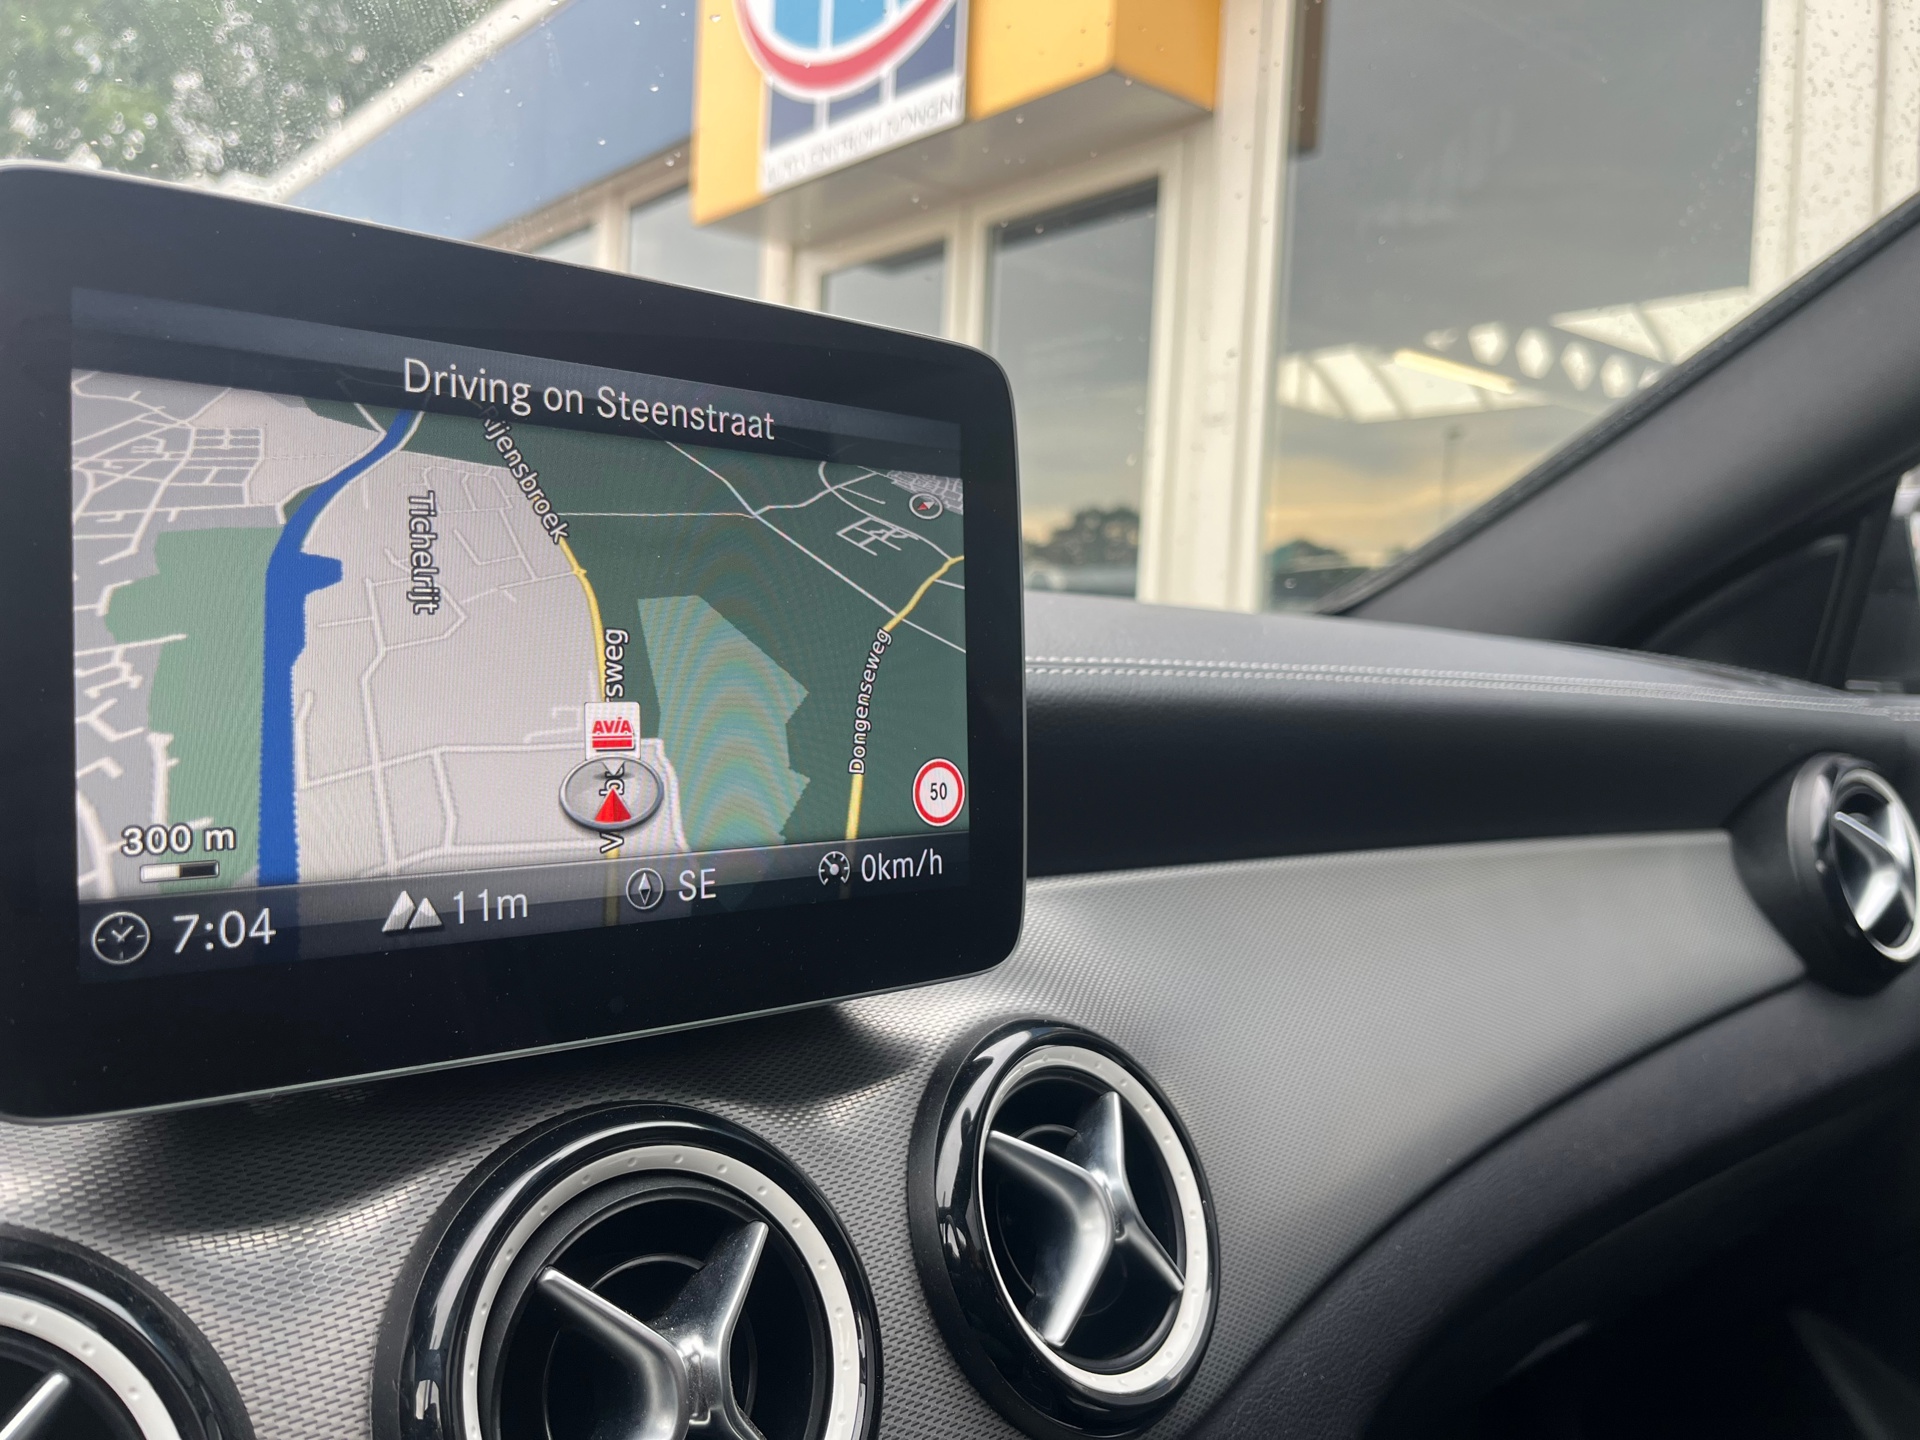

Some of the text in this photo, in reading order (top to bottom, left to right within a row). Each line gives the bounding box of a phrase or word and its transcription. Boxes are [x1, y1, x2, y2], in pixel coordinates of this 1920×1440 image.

[404, 357, 775, 440] Driving on Steenstraat
[408, 490, 440, 615] Tichelrijt
[849, 628, 892, 774] Dongenseweg
[930, 782, 948, 801] 50
[121, 824, 236, 855] 300 m
[861, 849, 943, 882] 0km/h
[678, 868, 717, 901] SE
[453, 889, 529, 925] 11m
[172, 907, 277, 954] 7:04
